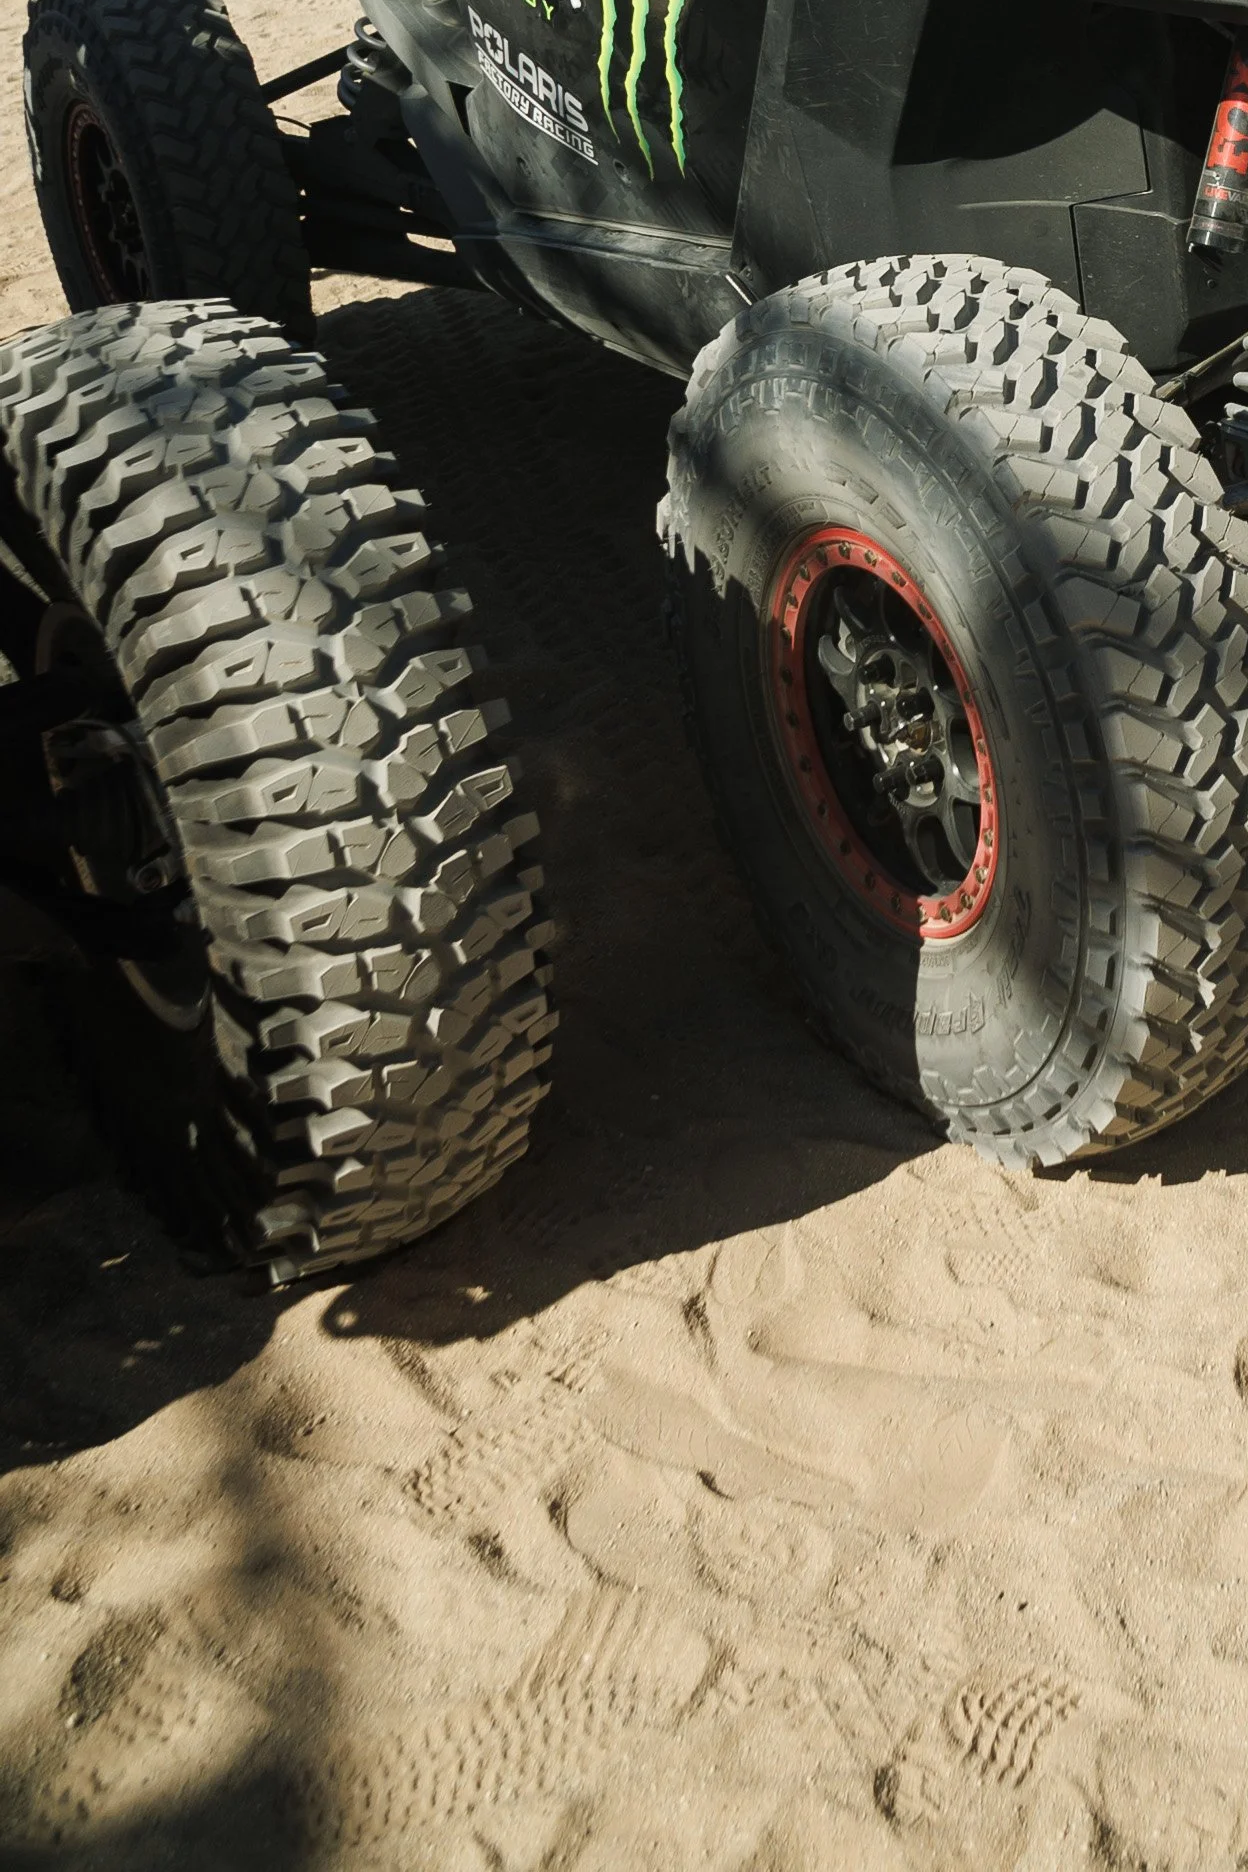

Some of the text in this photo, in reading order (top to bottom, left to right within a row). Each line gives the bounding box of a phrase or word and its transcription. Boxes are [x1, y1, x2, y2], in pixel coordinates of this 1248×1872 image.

[468, 5, 589, 133] POLARIS
[478, 49, 595, 159] FACTORY RACING
